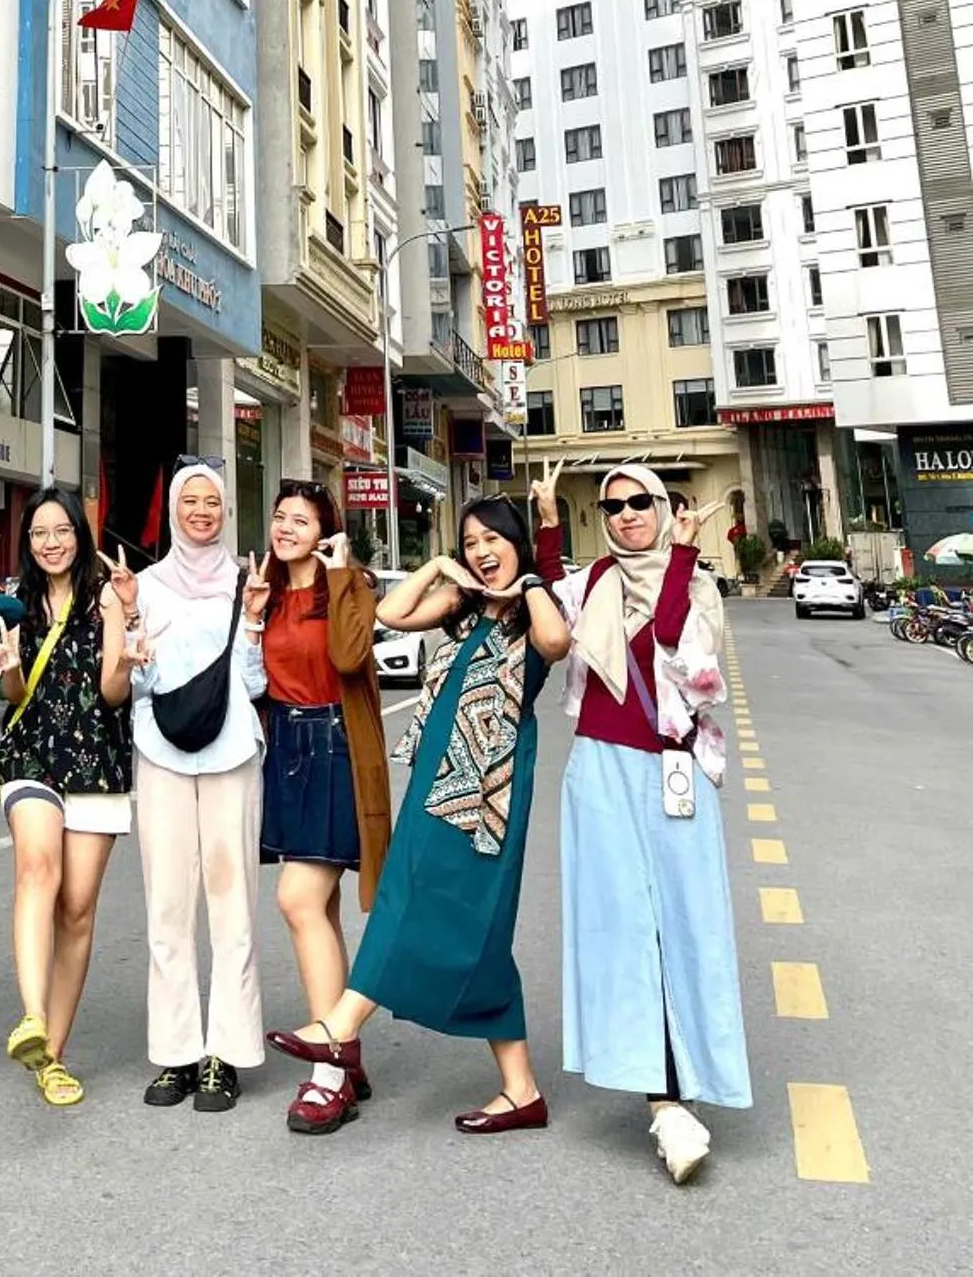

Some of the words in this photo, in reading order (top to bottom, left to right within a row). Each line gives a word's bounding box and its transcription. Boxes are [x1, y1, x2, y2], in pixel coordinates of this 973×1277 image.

[524, 207, 560, 224] A25
[483, 219, 506, 338] VICTORIA
[525, 229, 543, 320] HOTEL
[492, 343, 527, 360] Hotel
[915, 451, 945, 471] HA
[945, 450, 973, 470] LO
